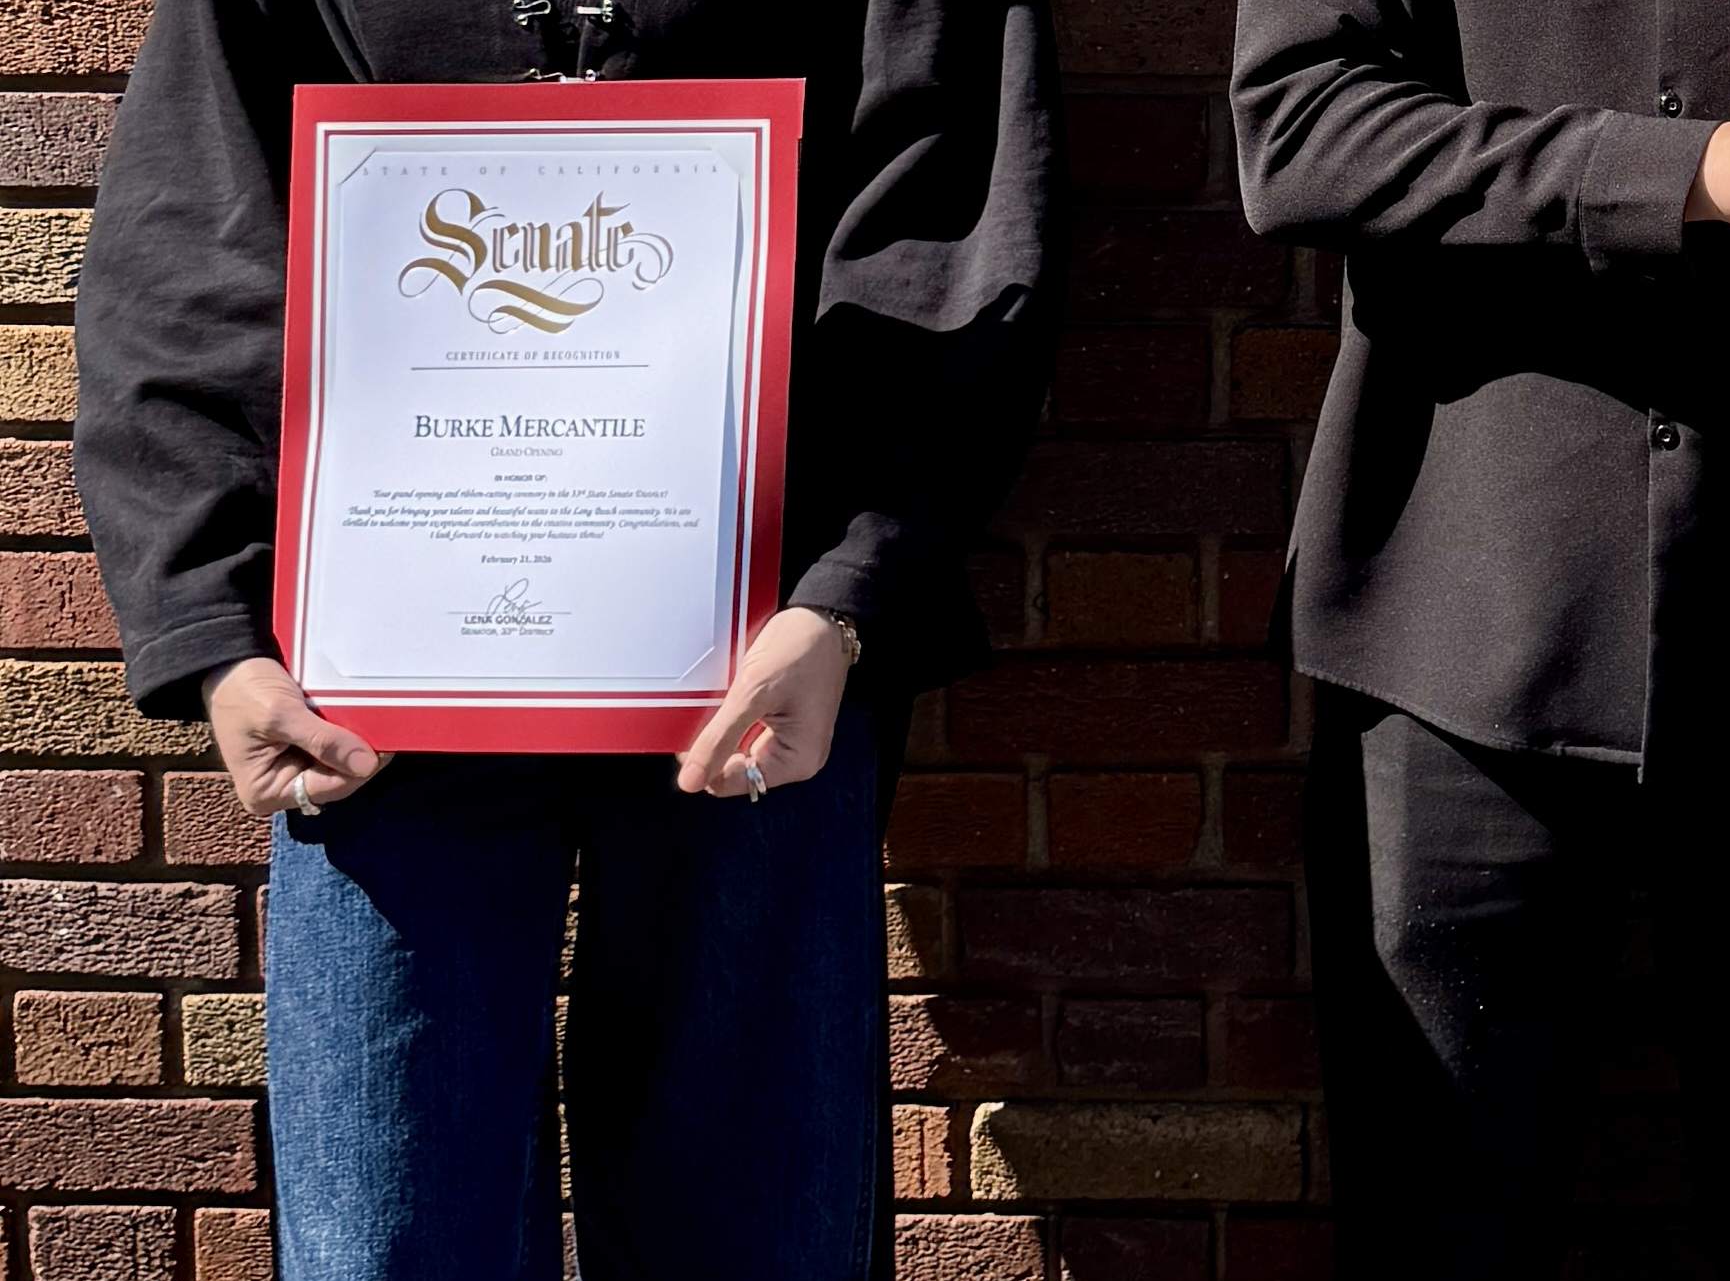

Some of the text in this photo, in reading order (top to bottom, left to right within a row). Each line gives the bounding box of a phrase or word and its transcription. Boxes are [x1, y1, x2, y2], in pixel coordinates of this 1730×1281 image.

[362, 164, 717, 176] STATE OF CALIFORNIA
[398, 188, 674, 335] Senate
[445, 350, 620, 360] CERTIFICATE OF RECOGNITION
[414, 414, 646, 438] BURKE MERCANTILE
